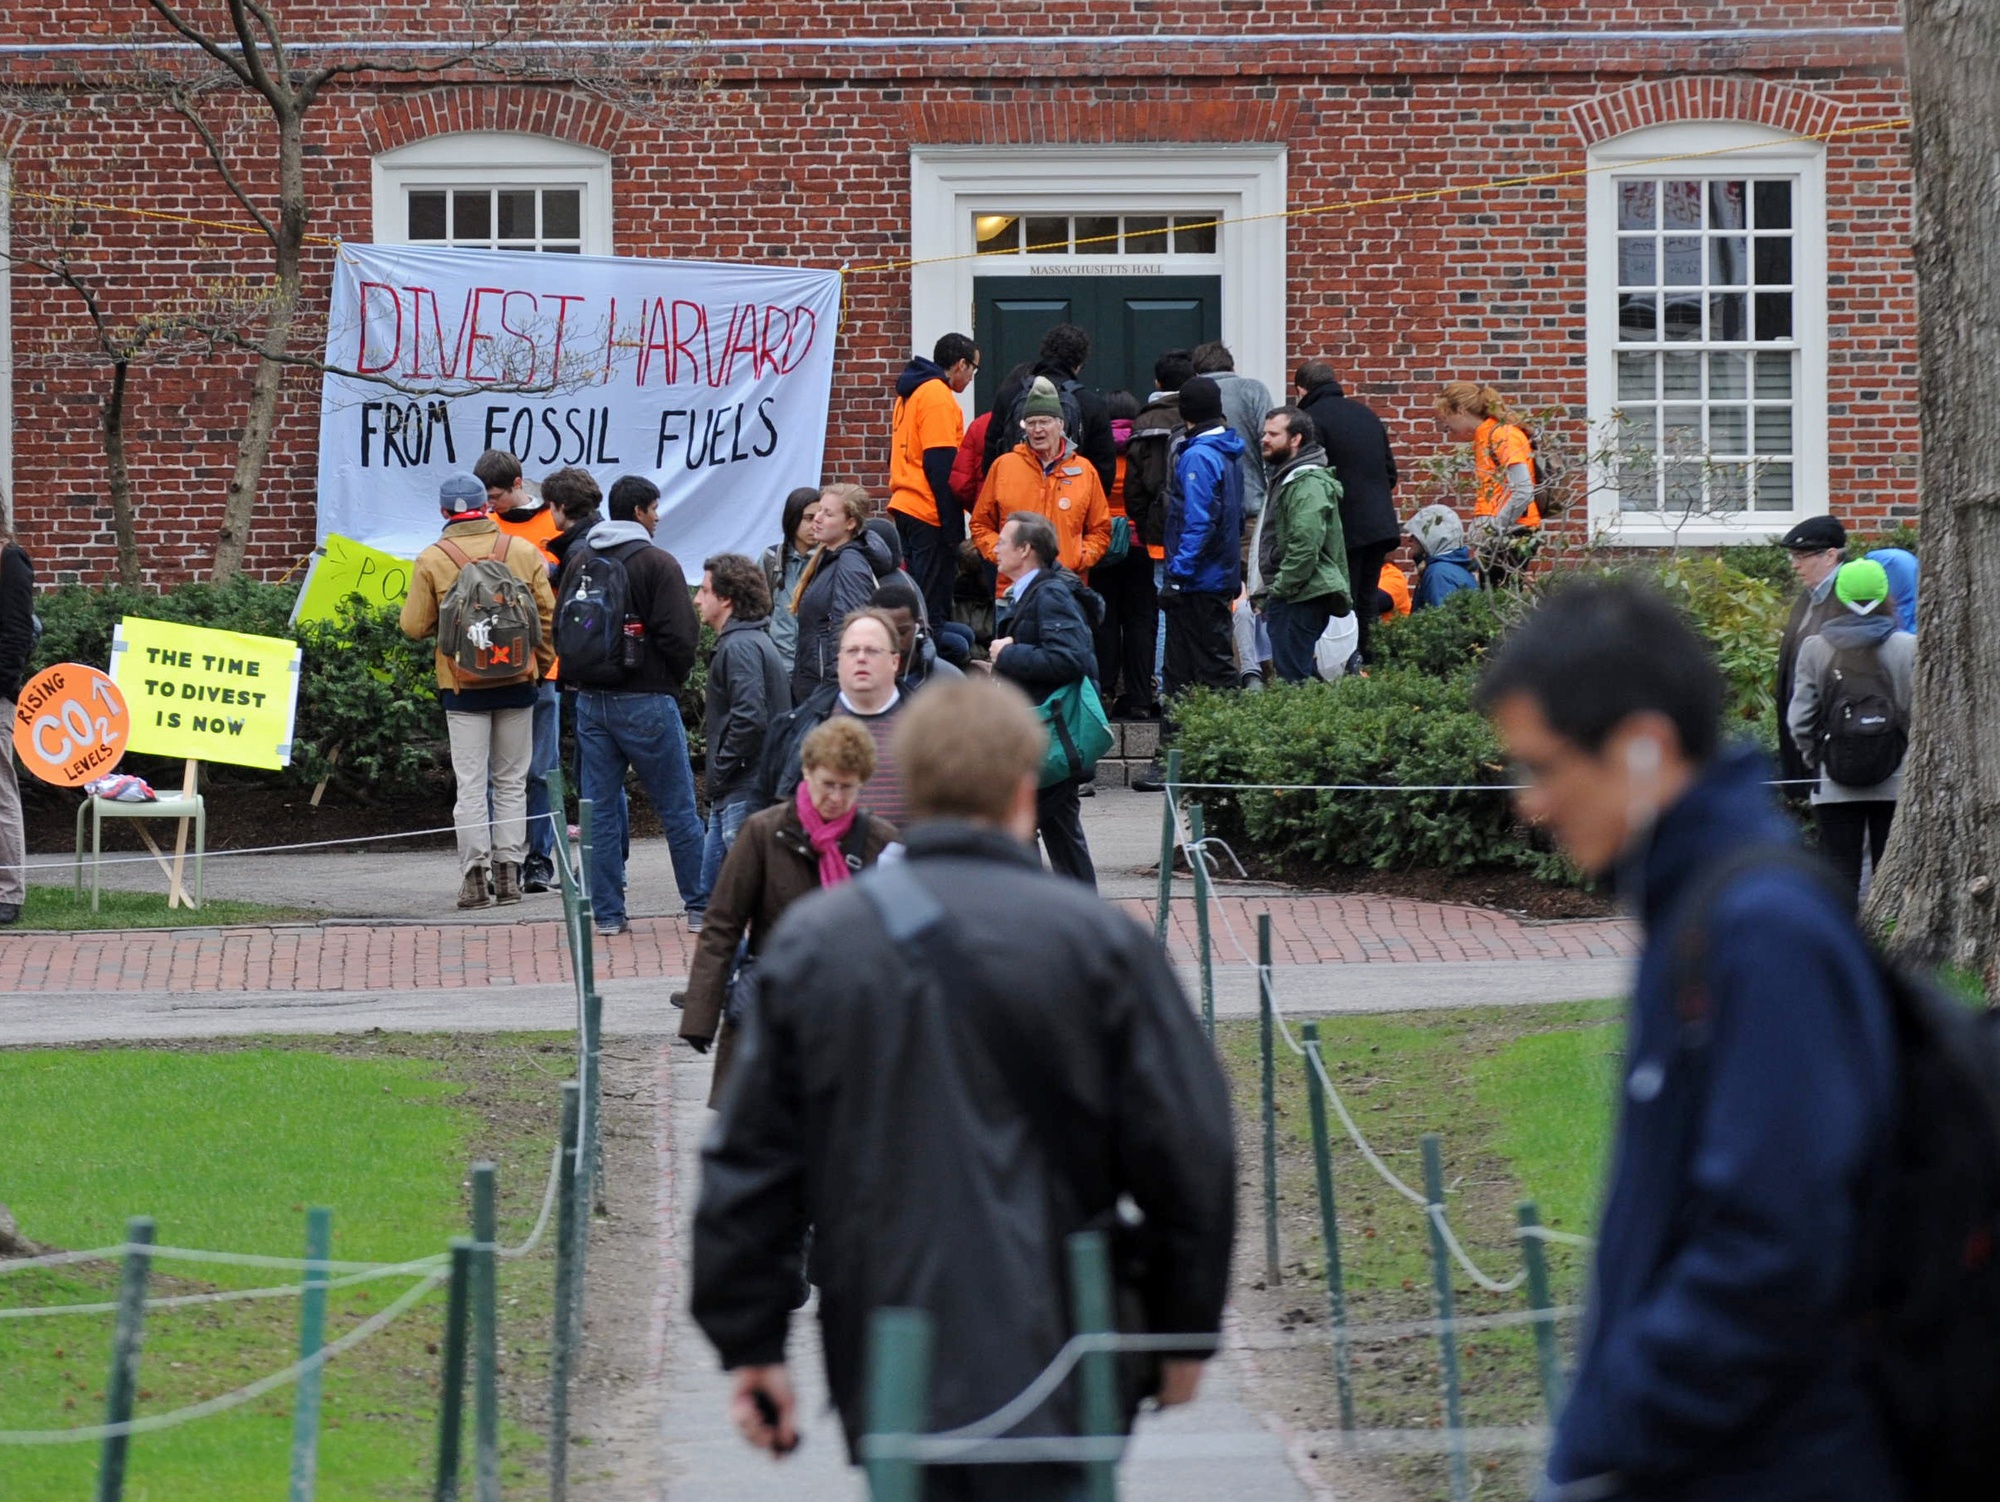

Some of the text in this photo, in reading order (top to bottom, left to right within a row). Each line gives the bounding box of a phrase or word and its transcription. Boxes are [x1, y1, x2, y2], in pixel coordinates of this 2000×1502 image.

[1030, 264, 1164, 275] MASSACHUSETTS HALL
[357, 281, 816, 387] DIVEST HARVARD
[360, 397, 778, 470] FROM FOSSIL FUELS
[146, 647, 260, 676] THE TIME
[17, 671, 66, 725] RISING
[144, 679, 266, 708] TO DIVEST
[156, 711, 245, 736] IS NOW
[62, 743, 114, 782] LEVELS
